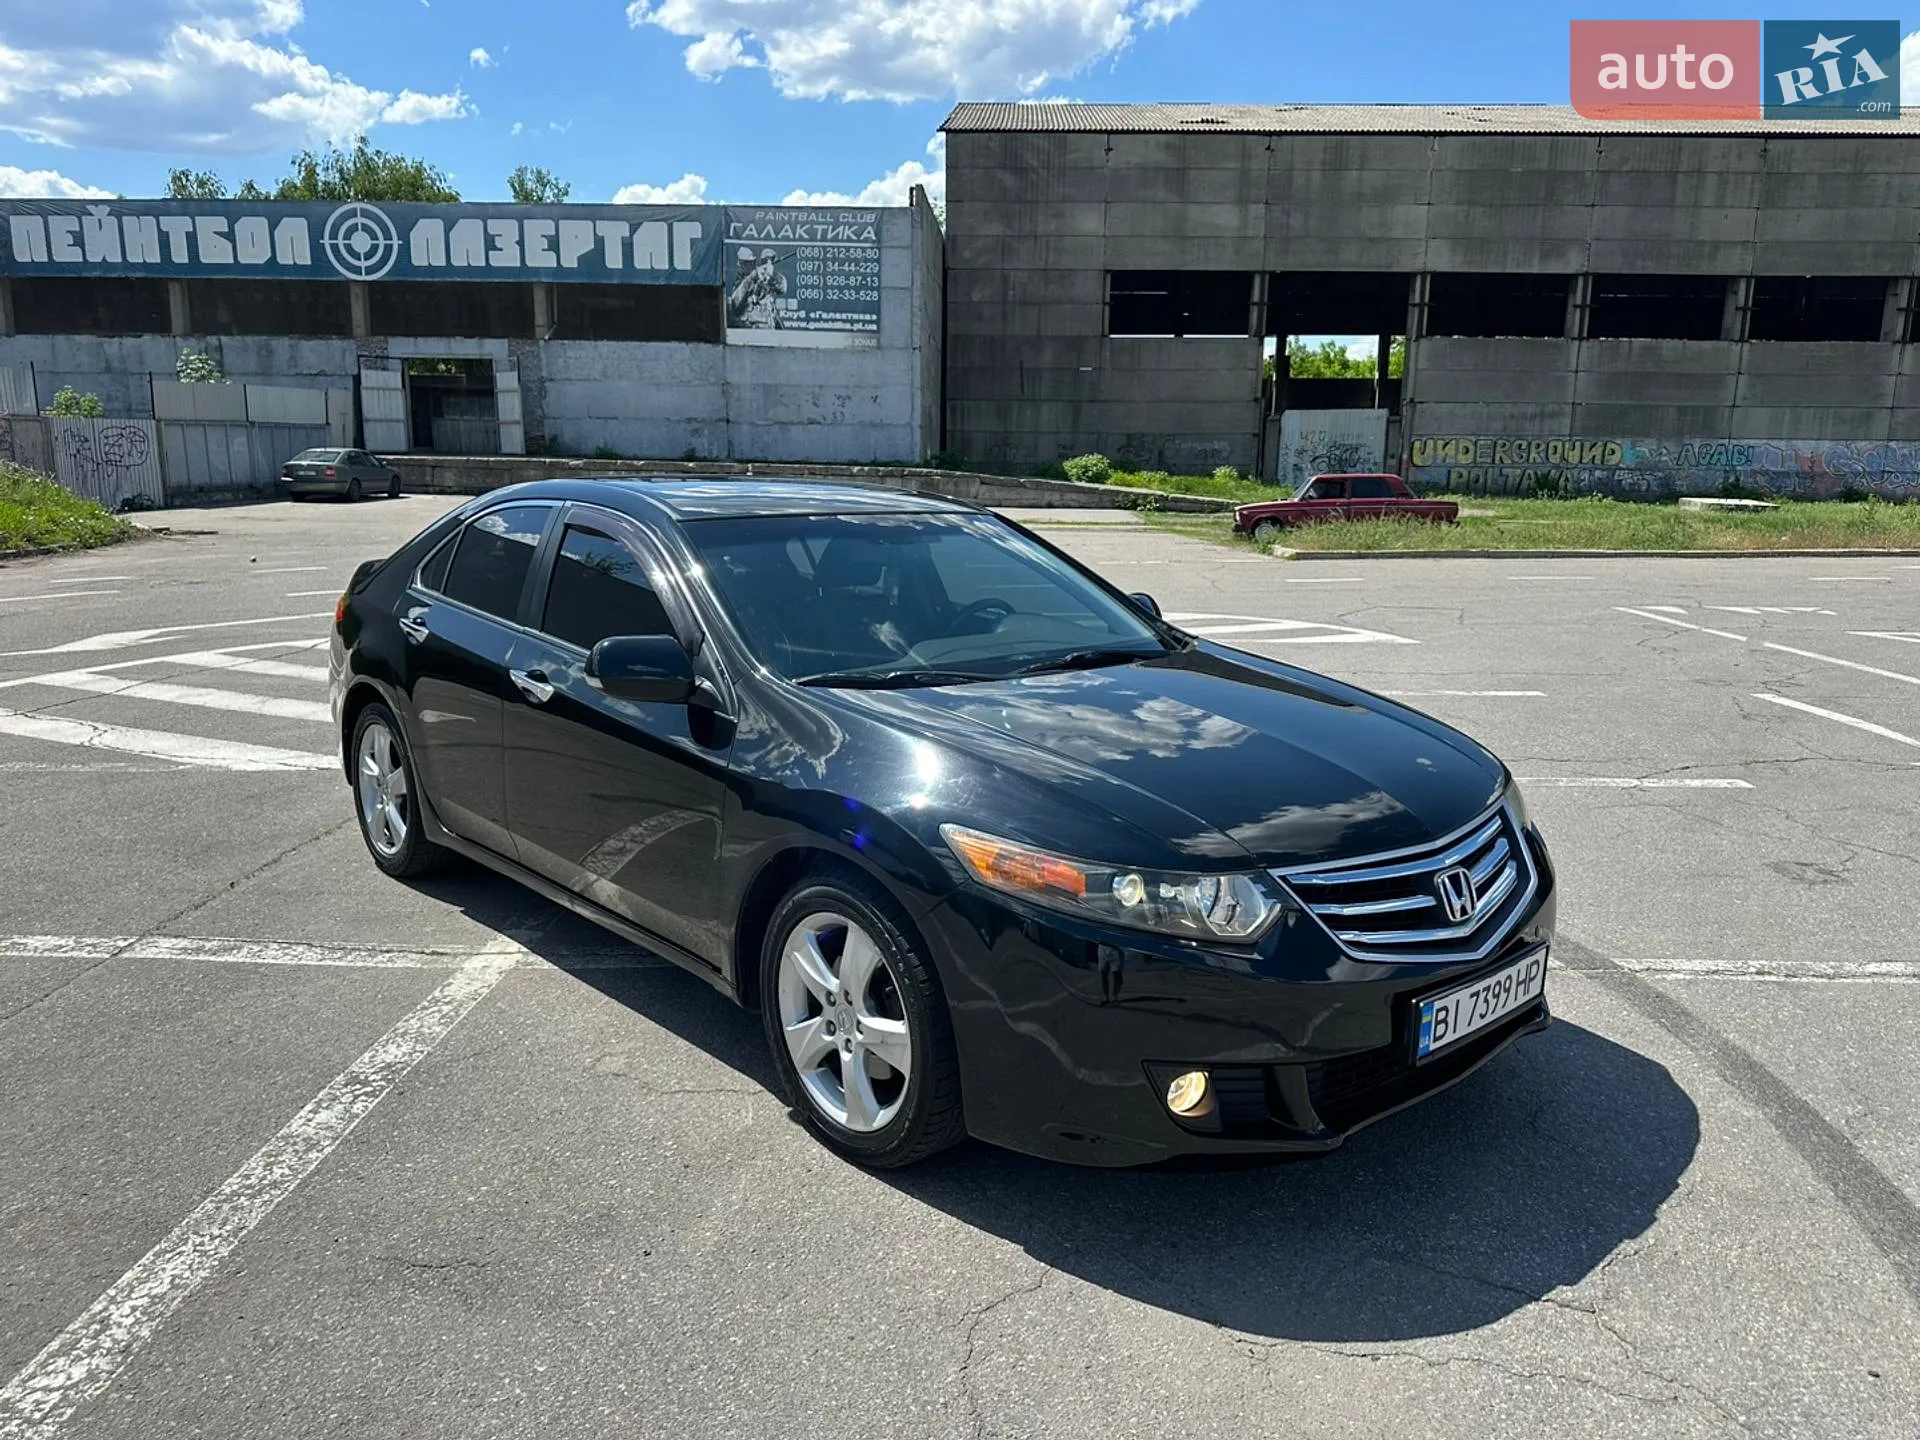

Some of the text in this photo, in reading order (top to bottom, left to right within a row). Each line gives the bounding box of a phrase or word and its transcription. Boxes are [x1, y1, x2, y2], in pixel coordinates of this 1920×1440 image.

[729, 222, 877, 241] ГАЛАКТИКА
[755, 211, 877, 223] PAINTBALL CLUB
[9, 204, 702, 270] ПЕЙНТБОЛ ЛАЗЕРТАГ
[1411, 438, 1623, 467] UNDERGROUND
[1433, 959, 1540, 1043] BI 7399 HP
